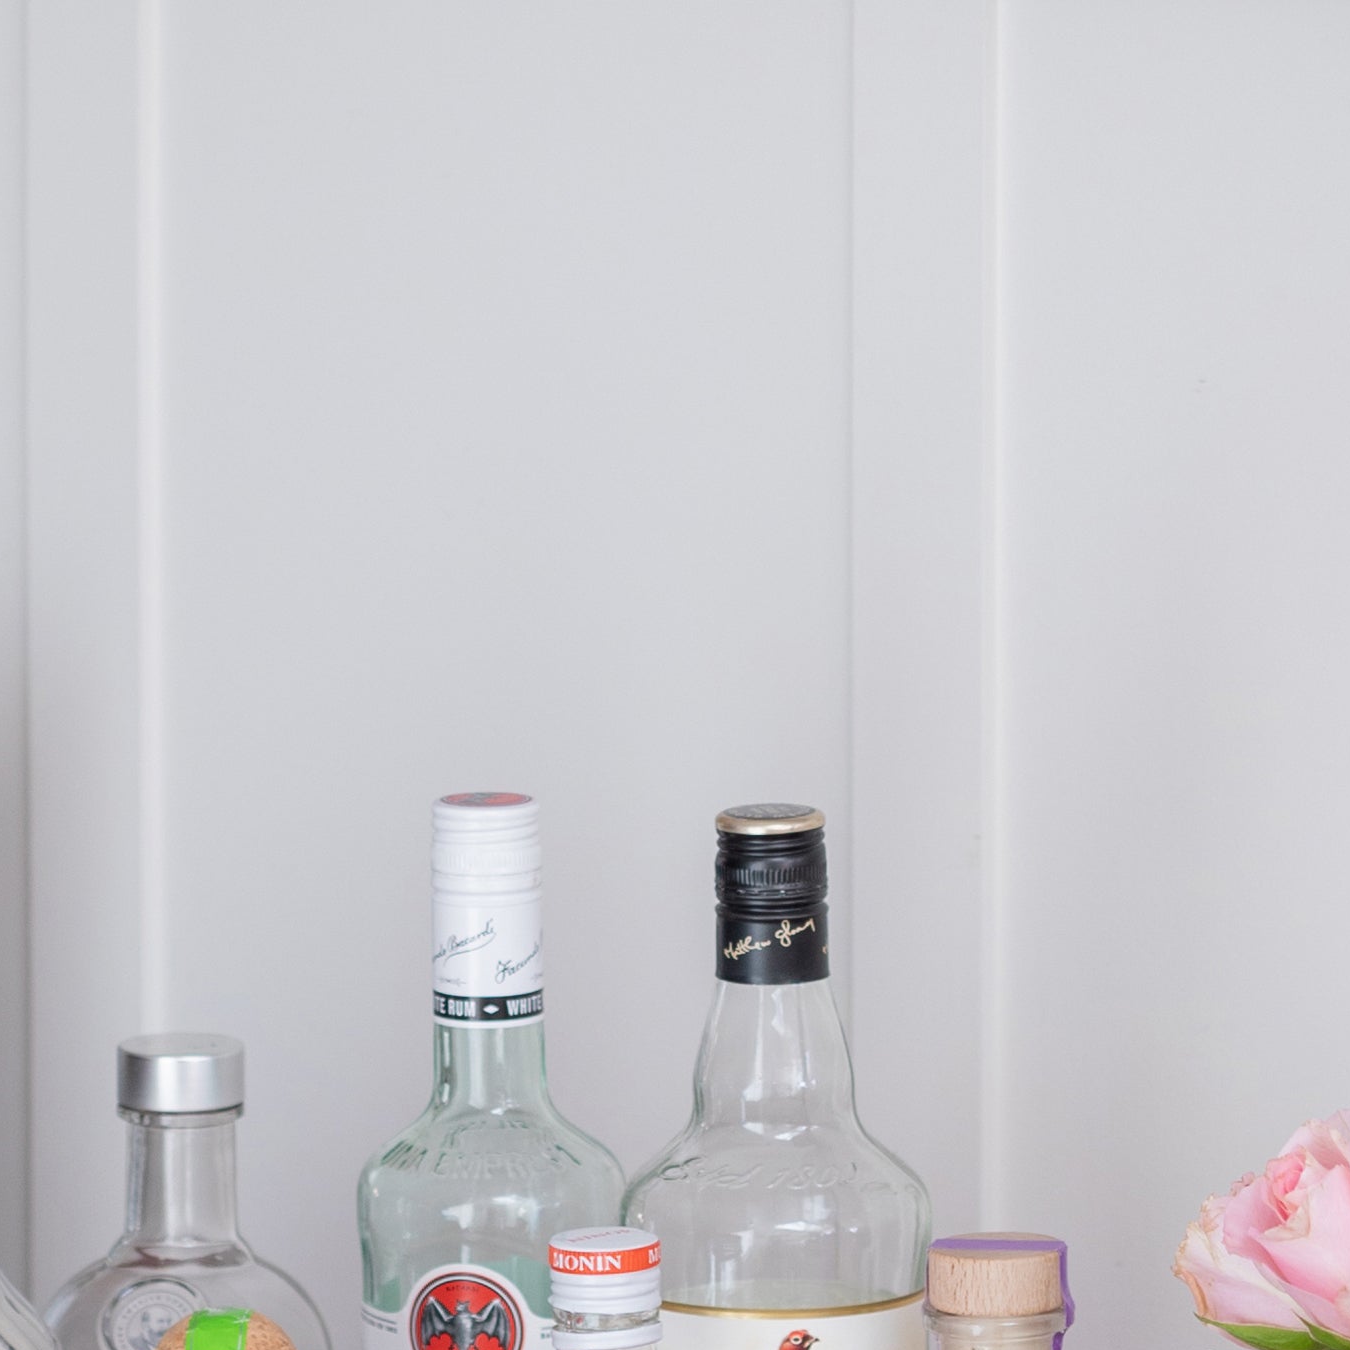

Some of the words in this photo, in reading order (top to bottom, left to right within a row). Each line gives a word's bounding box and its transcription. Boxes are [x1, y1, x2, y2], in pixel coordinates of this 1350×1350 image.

[447, 999, 476, 1018] RUM
[506, 993, 543, 1017] WHITE
[648, 1247, 661, 1264] M
